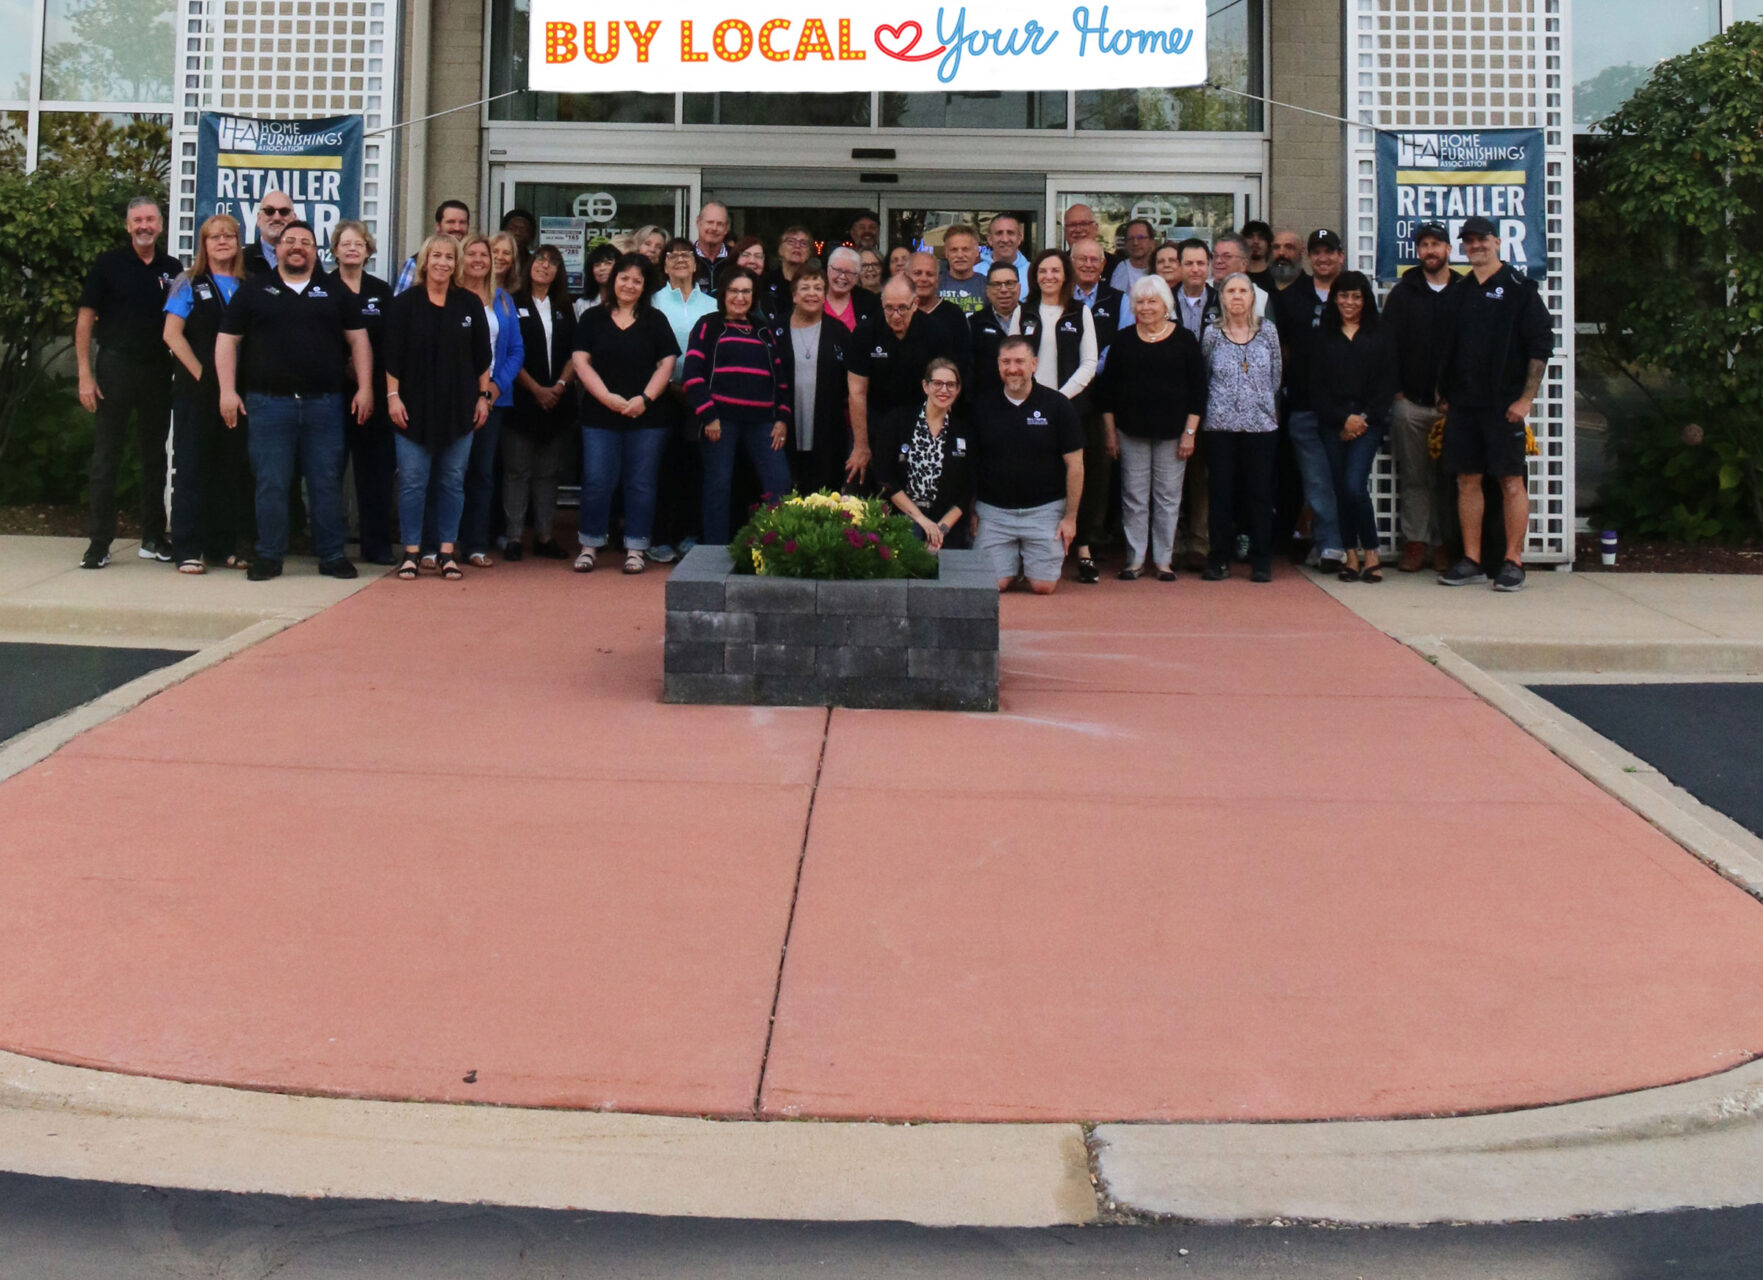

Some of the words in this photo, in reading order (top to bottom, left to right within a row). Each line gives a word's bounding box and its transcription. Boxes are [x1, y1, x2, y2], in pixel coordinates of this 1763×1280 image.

[546, 20, 662, 64] BUY
[681, 18, 867, 63] LOCAL
[936, 6, 1060, 83] Your
[1073, 5, 1194, 57] Home
[260, 122, 301, 135] HOME
[259, 133, 343, 147] FURNISHINGS
[1439, 134, 1480, 148] HOME
[1440, 146, 1526, 161] FURNISHINGS
[1439, 160, 1488, 168] ASSOCIATION
[217, 168, 341, 202] RETAILER
[1397, 186, 1526, 217] RETAILER
[216, 202, 233, 216] OF
[1319, 230, 1328, 239] P
[1396, 220, 1415, 239] OF
[1396, 241, 1419, 259] TH
